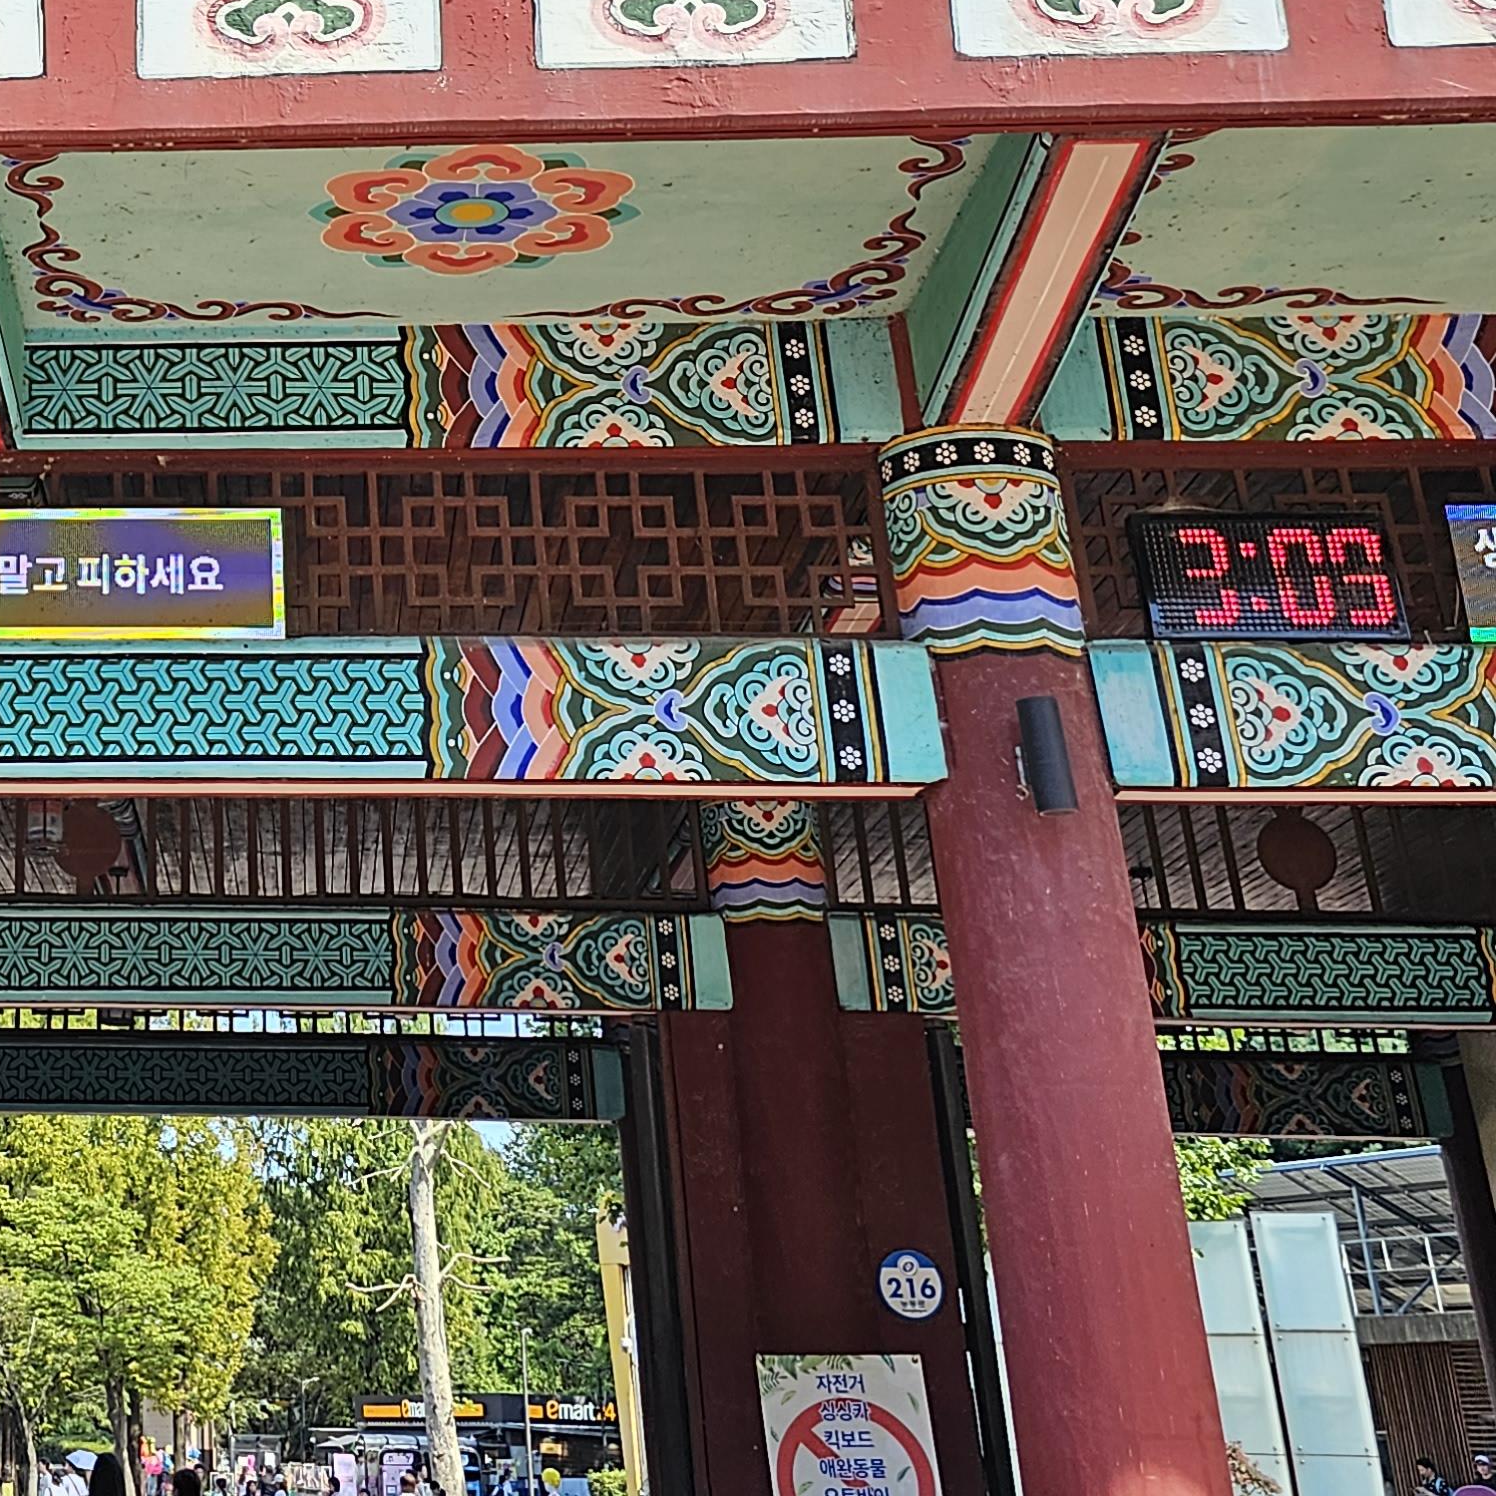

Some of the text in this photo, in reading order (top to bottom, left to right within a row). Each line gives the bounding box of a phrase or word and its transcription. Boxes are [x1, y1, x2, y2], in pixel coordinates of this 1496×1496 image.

[77, 553, 224, 596] 피하세요
[887, 1277, 936, 1299] 216
[816, 1373, 866, 1394] 자전거
[820, 1401, 869, 1422] 싱싱카
[824, 1430, 875, 1450] 킥보드
[819, 1458, 887, 1479] 애완동물
